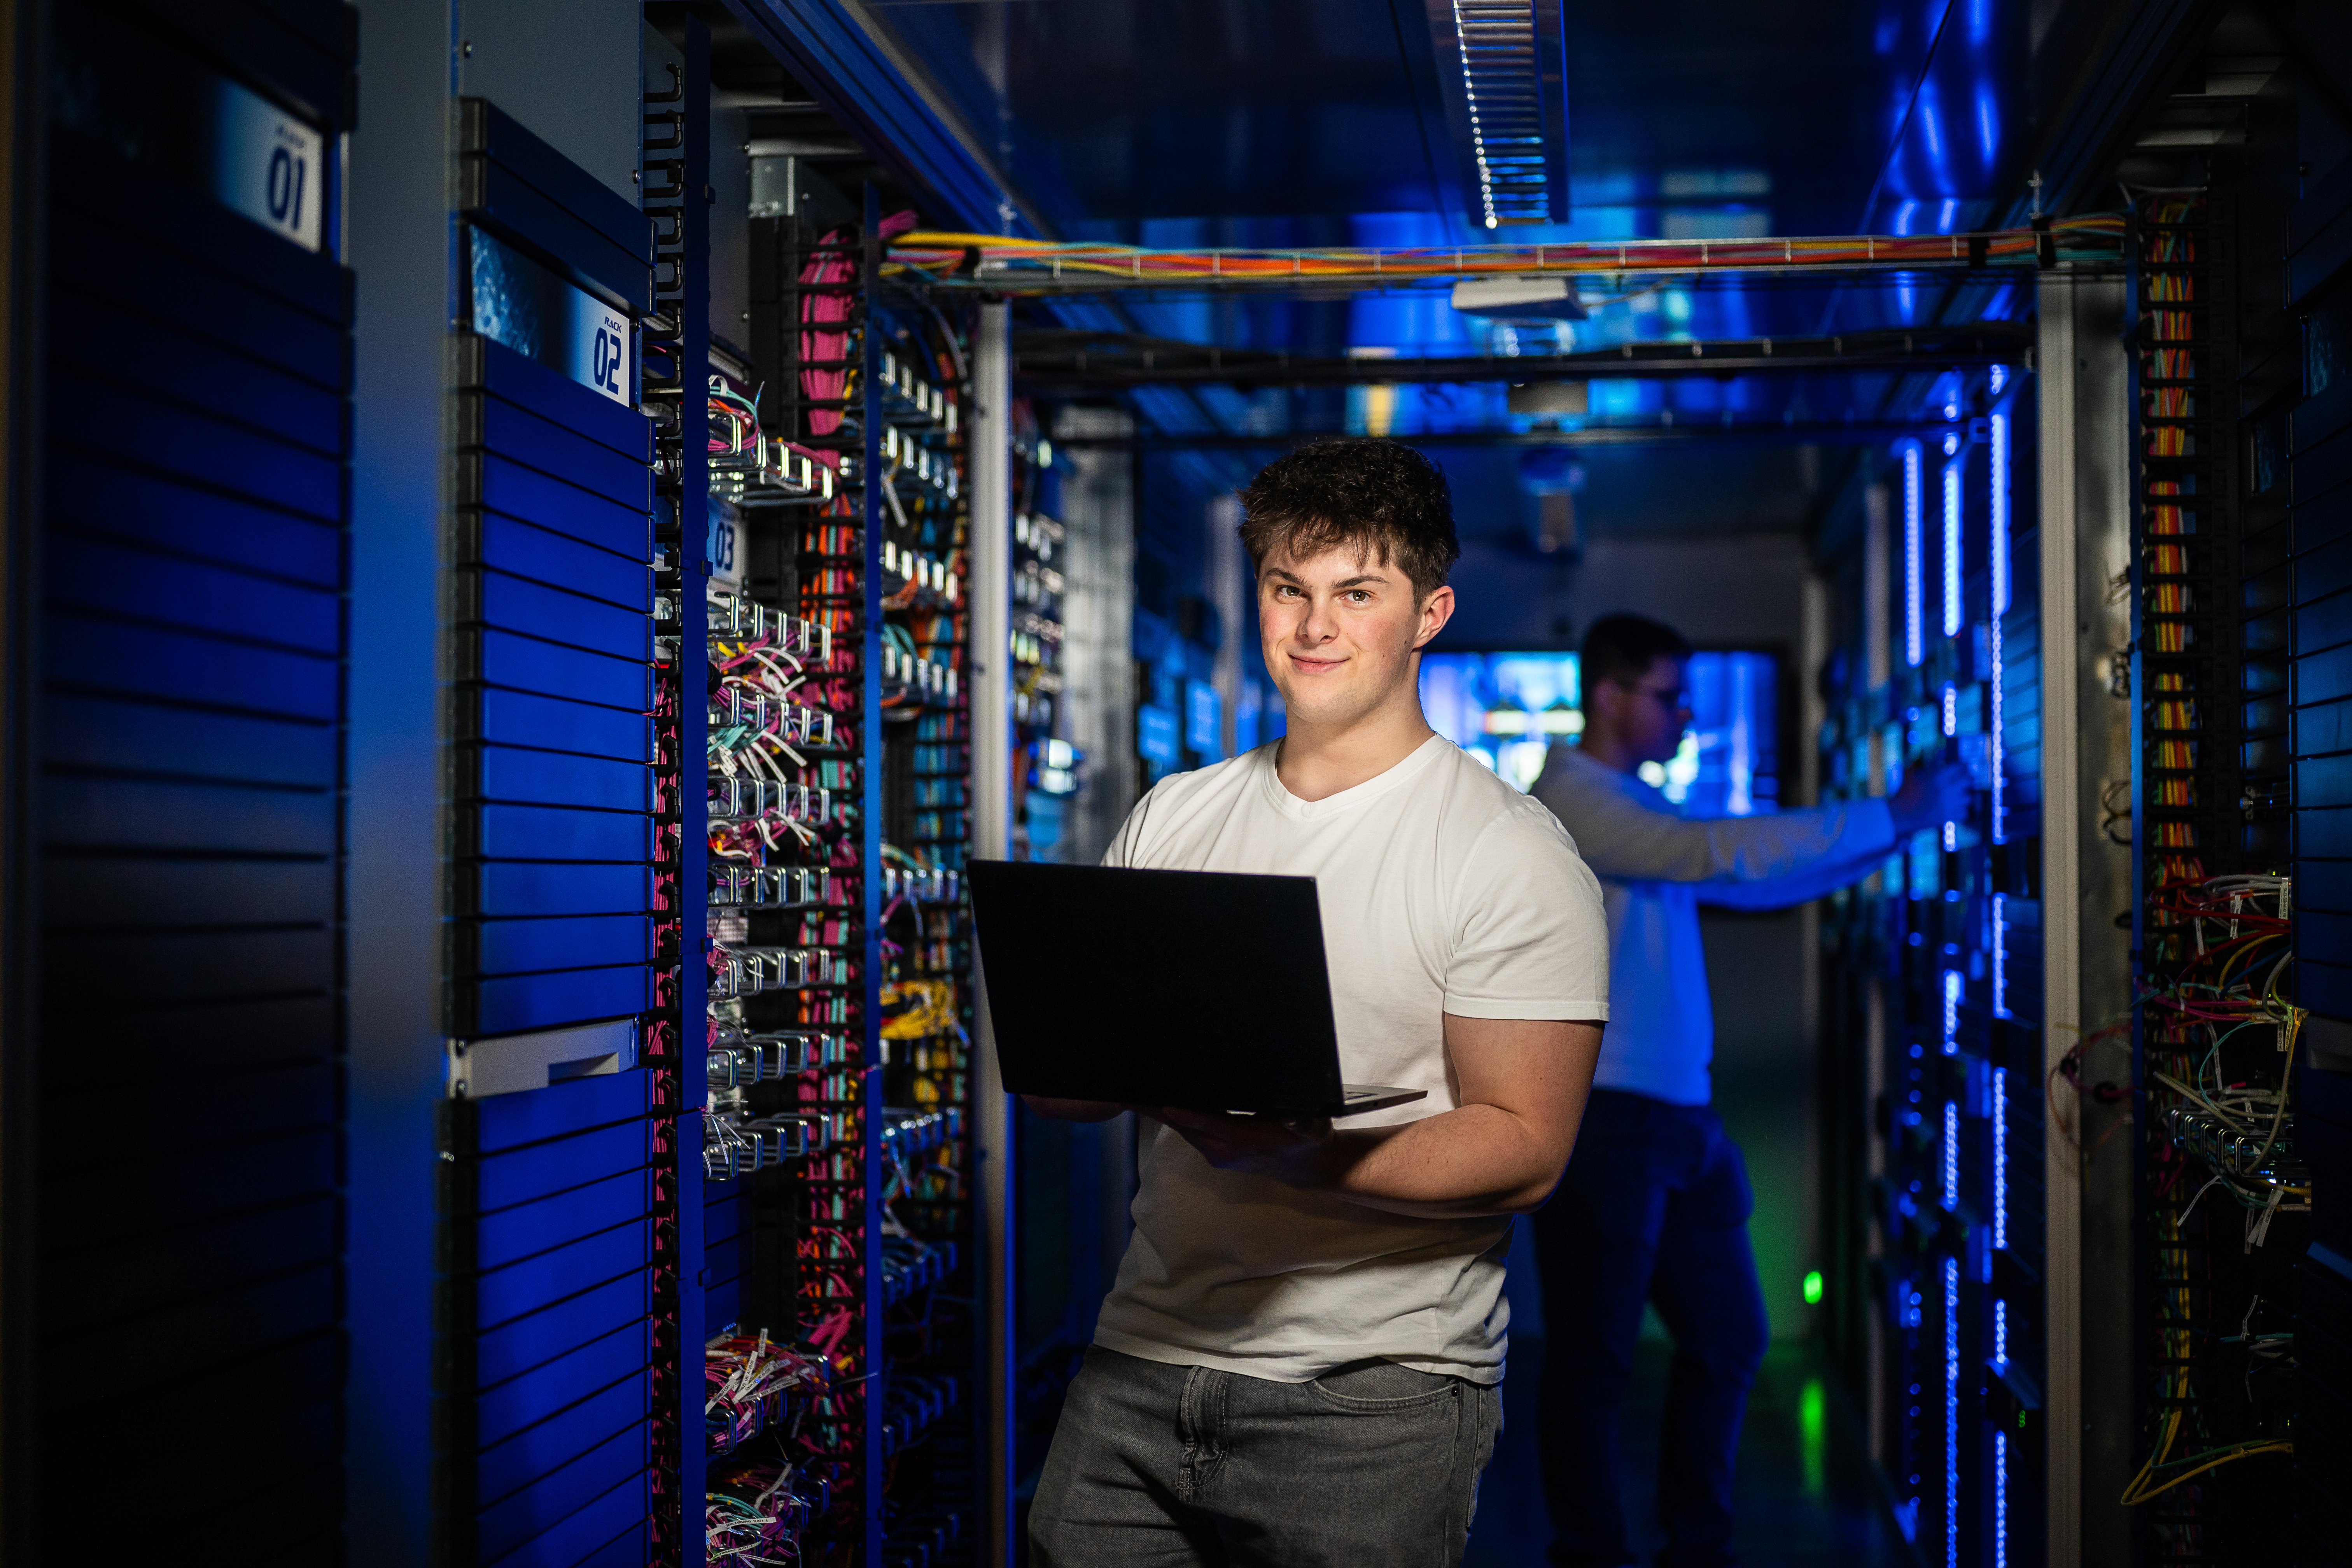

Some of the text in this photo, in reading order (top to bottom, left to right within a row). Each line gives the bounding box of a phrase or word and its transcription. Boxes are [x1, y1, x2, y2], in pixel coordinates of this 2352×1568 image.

[269, 147, 304, 229] 01
[605, 316, 622, 334] RACK
[594, 327, 621, 396] 02
[716, 522, 734, 570] 03
